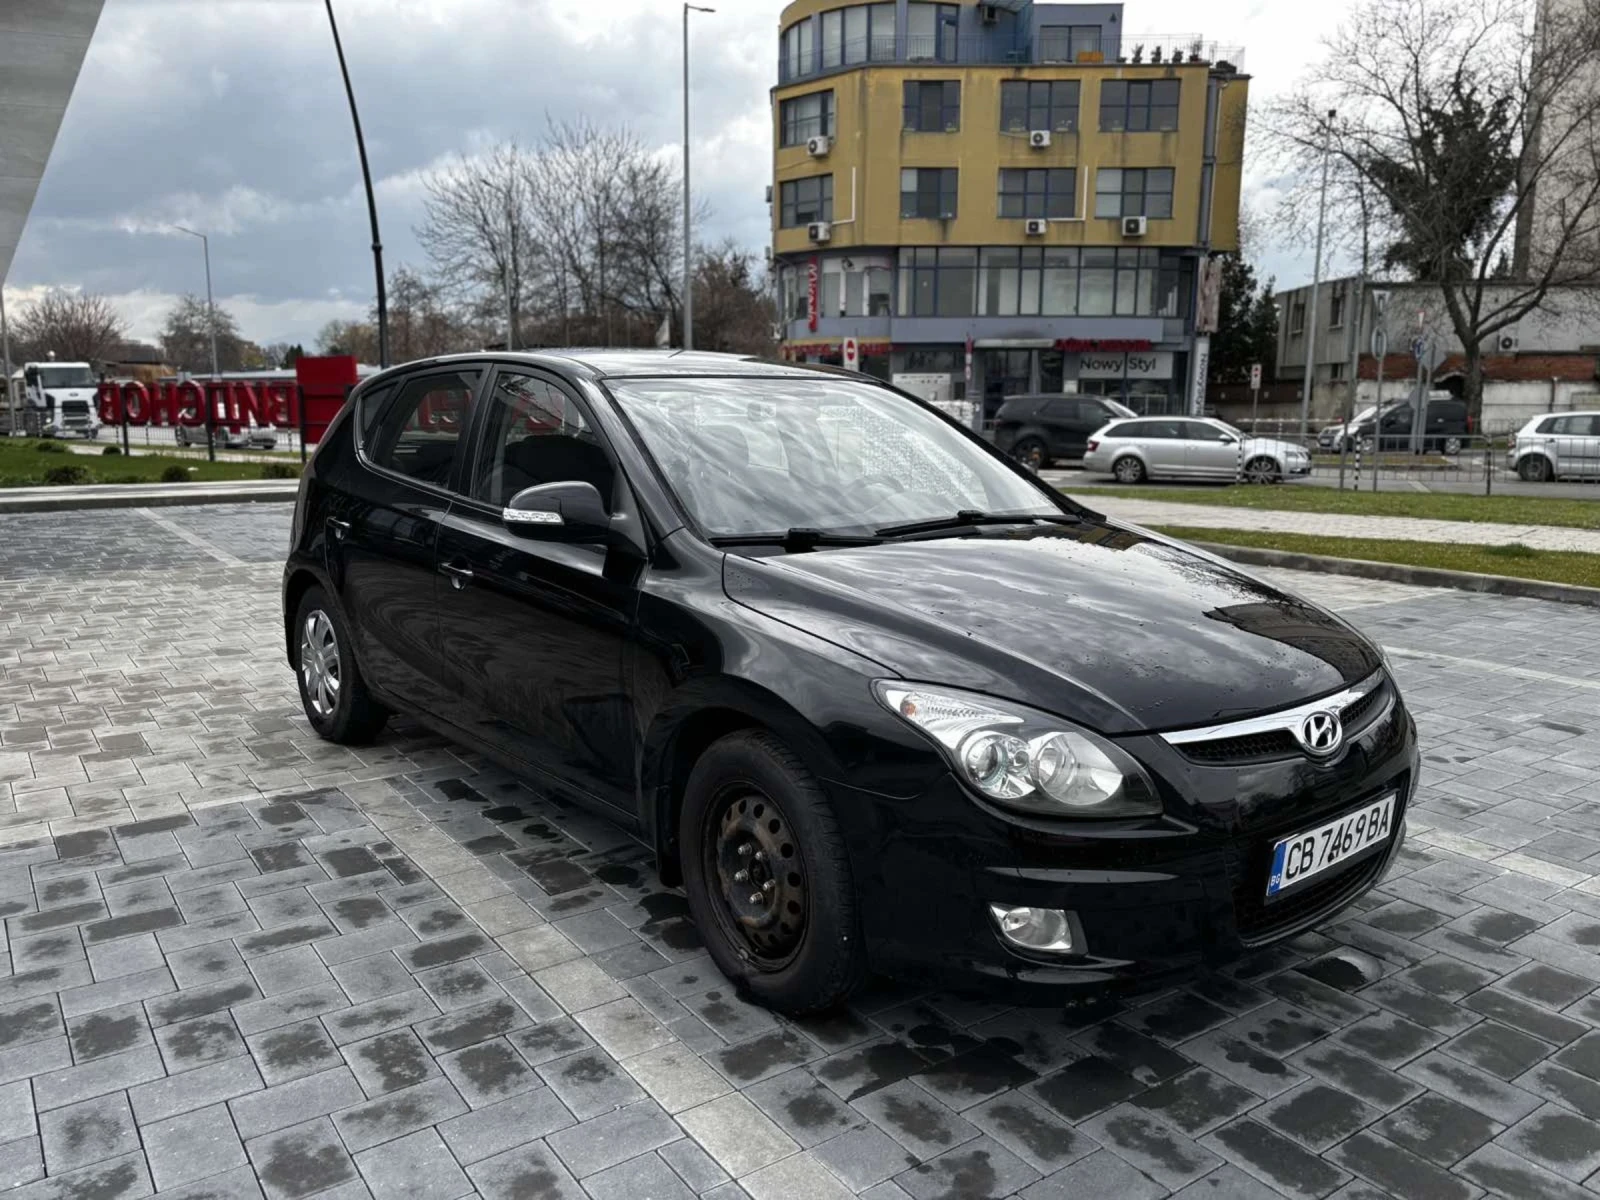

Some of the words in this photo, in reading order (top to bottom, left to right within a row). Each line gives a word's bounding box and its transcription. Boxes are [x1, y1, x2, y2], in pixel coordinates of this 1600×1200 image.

[1080, 357, 1123, 372] Nowy
[1128, 356, 1156, 372] Styl
[1286, 836, 1315, 880] CB
[1318, 813, 1366, 867] 7469
[1366, 802, 1390, 842] BA
[1270, 873, 1281, 887] BG
